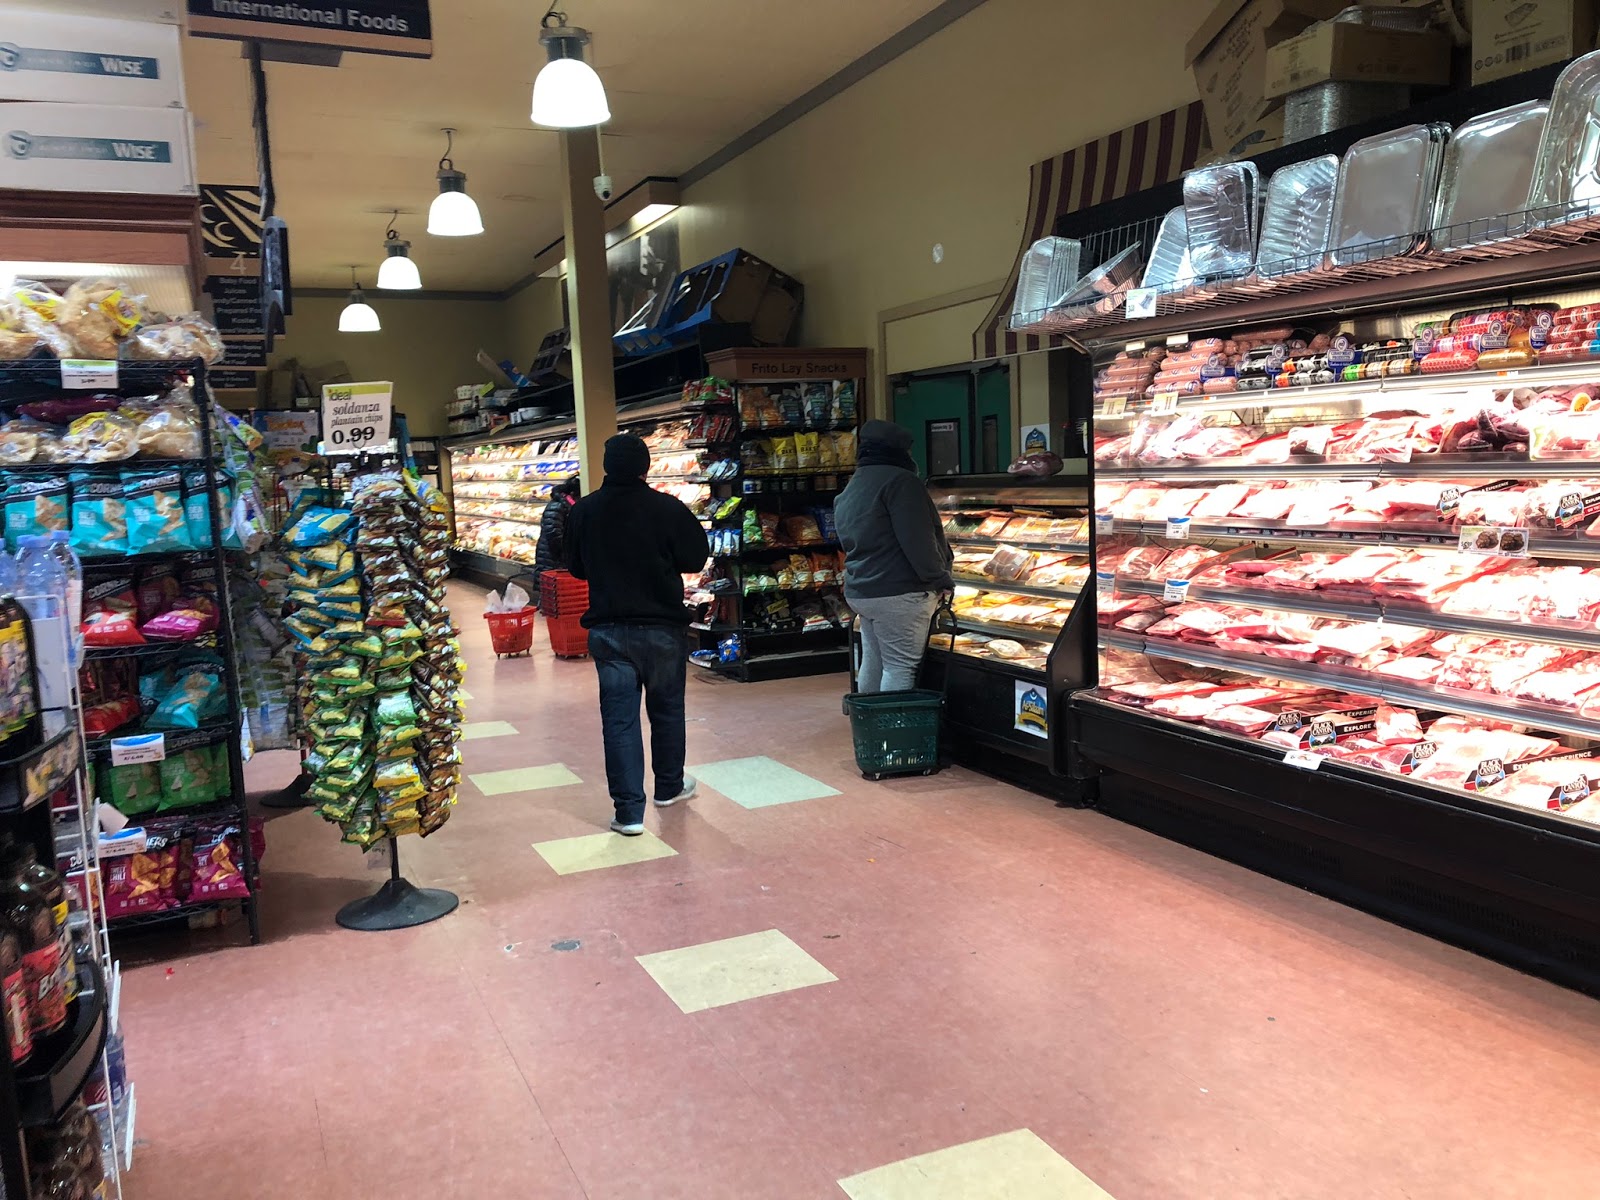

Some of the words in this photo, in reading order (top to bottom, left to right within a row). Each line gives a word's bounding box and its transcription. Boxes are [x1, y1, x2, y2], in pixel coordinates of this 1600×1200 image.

[212, 0, 342, 25] International
[347, 9, 409, 32] Foods
[100, 57, 145, 75] WISE
[111, 142, 157, 160] WISE
[229, 251, 247, 275] 4
[239, 276, 258, 285] Food
[752, 363, 778, 374] Frito
[782, 363, 801, 375] Lay
[806, 363, 847, 373] Snacks
[329, 388, 352, 402] ideal
[332, 402, 380, 416] soldanza
[331, 415, 363, 428] plantain
[364, 414, 383, 424] chips
[332, 426, 375, 444] 0.99
[1280, 712, 1298, 720] BLACK
[1347, 709, 1377, 717] EXPERIEN
[1278, 718, 1298, 726] CANYON
[1313, 721, 1332, 730] BLACK
[1312, 727, 1333, 736] CANYON
[1343, 723, 1372, 733] EXPLORE
[1415, 743, 1434, 752] BLACK
[1413, 748, 1435, 759] CANYON
[1480, 759, 1502, 768] BLACK
[1479, 765, 1502, 775] CANYON
[1563, 779, 1587, 793] CANYON
